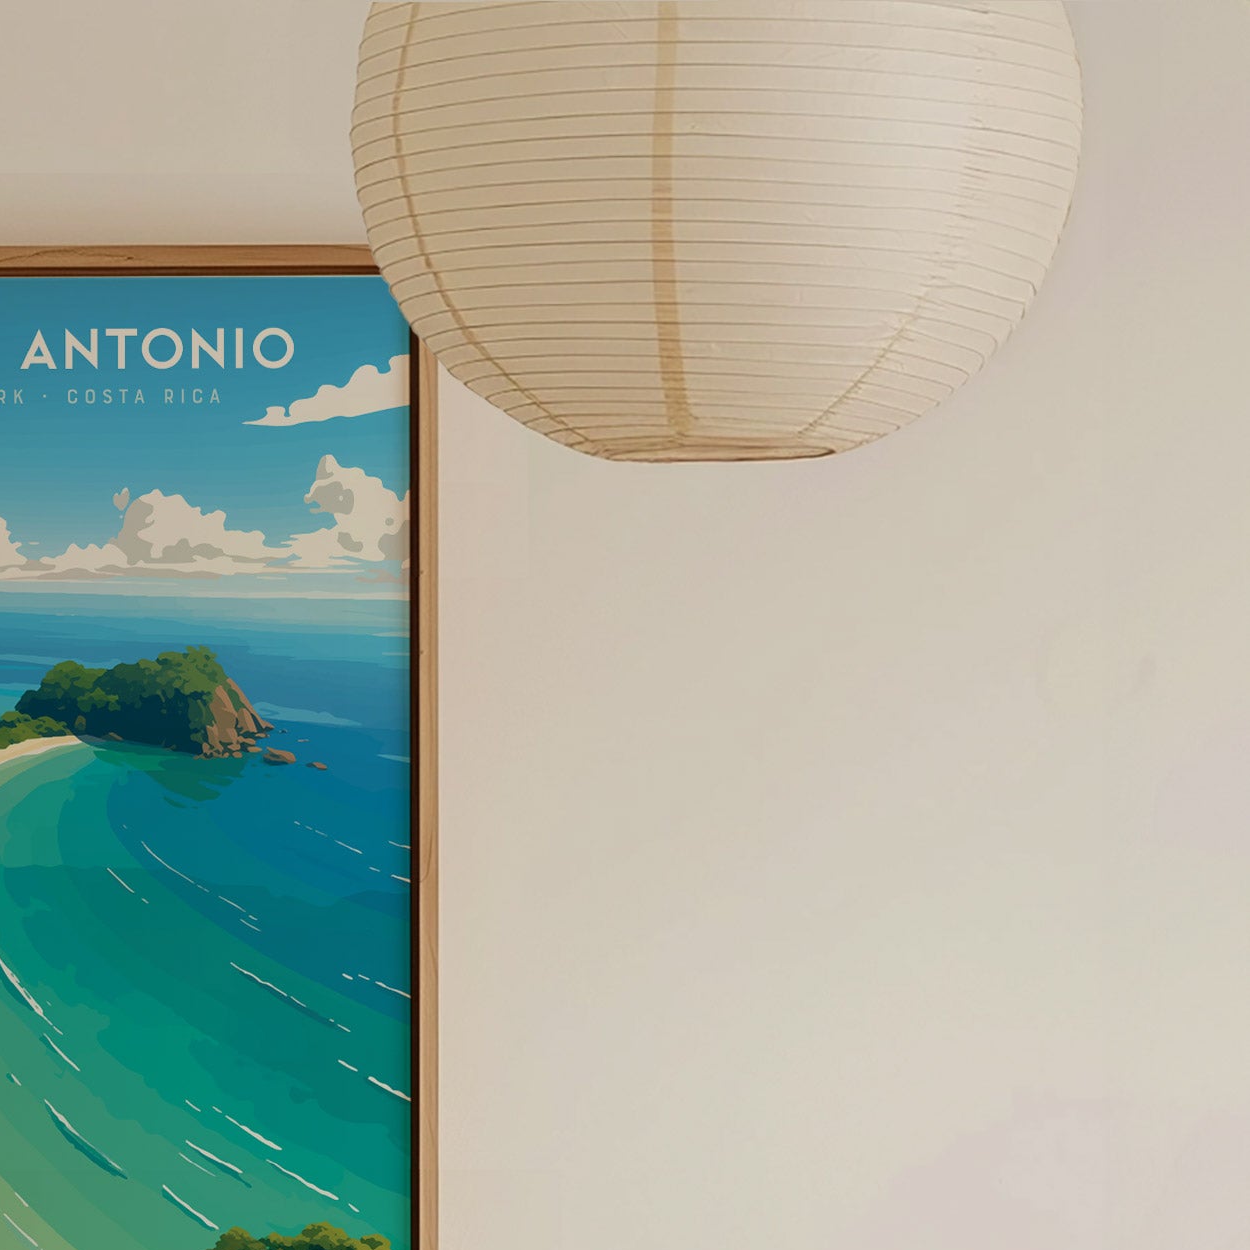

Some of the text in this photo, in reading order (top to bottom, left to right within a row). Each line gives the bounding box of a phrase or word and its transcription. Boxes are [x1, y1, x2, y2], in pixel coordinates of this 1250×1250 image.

[20, 327, 295, 371] ANTONIO
[66, 388, 146, 405] COSTA
[164, 388, 221, 404] RICA
